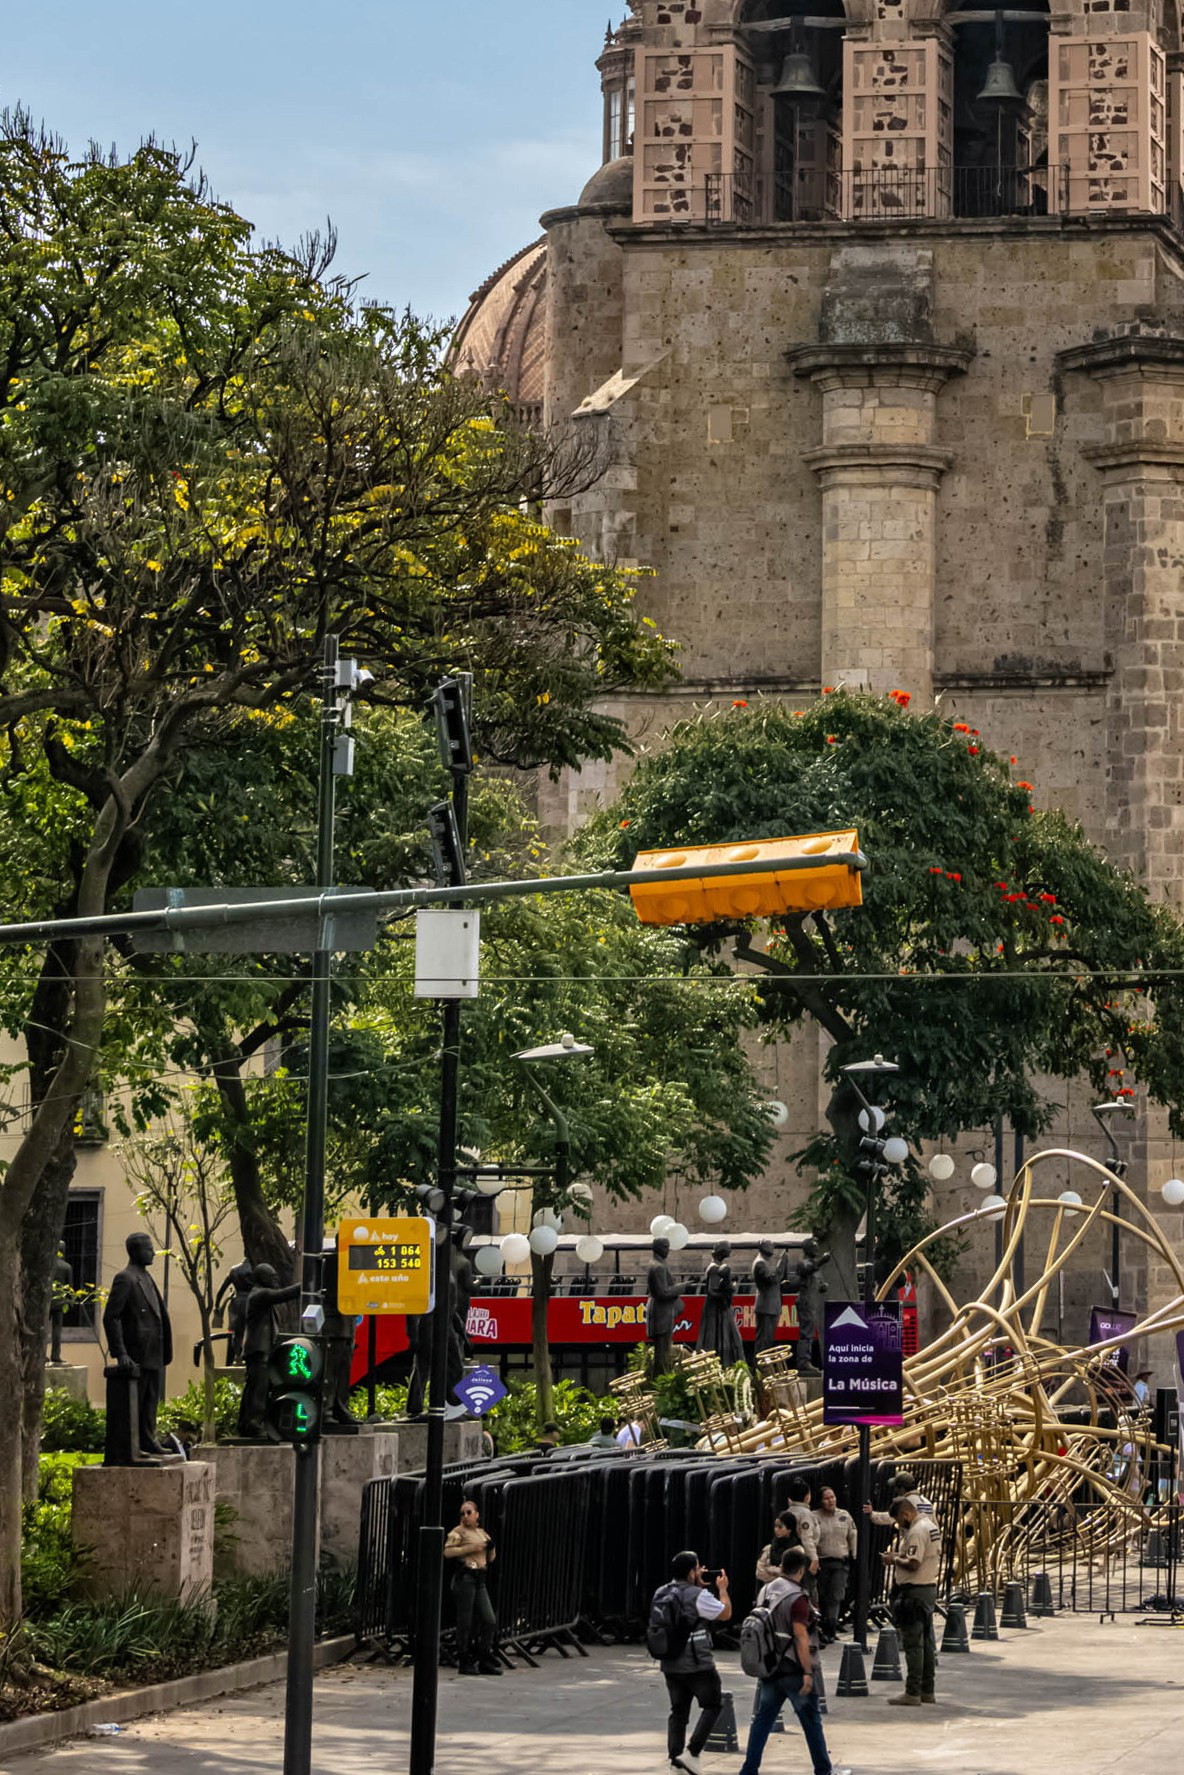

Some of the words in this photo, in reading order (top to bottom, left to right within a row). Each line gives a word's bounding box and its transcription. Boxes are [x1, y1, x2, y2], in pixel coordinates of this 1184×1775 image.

[382, 1232, 398, 1242] hoy
[391, 1246, 396, 1256] 1
[377, 1259, 396, 1268] 153
[579, 1300, 648, 1329] Tapat
[828, 1344, 849, 1353] Aquí
[851, 1344, 874, 1352] inicia
[828, 1355, 837, 1363] la
[861, 1355, 873, 1363] de
[828, 1378, 845, 1391] La
[849, 1377, 898, 1391] Música
